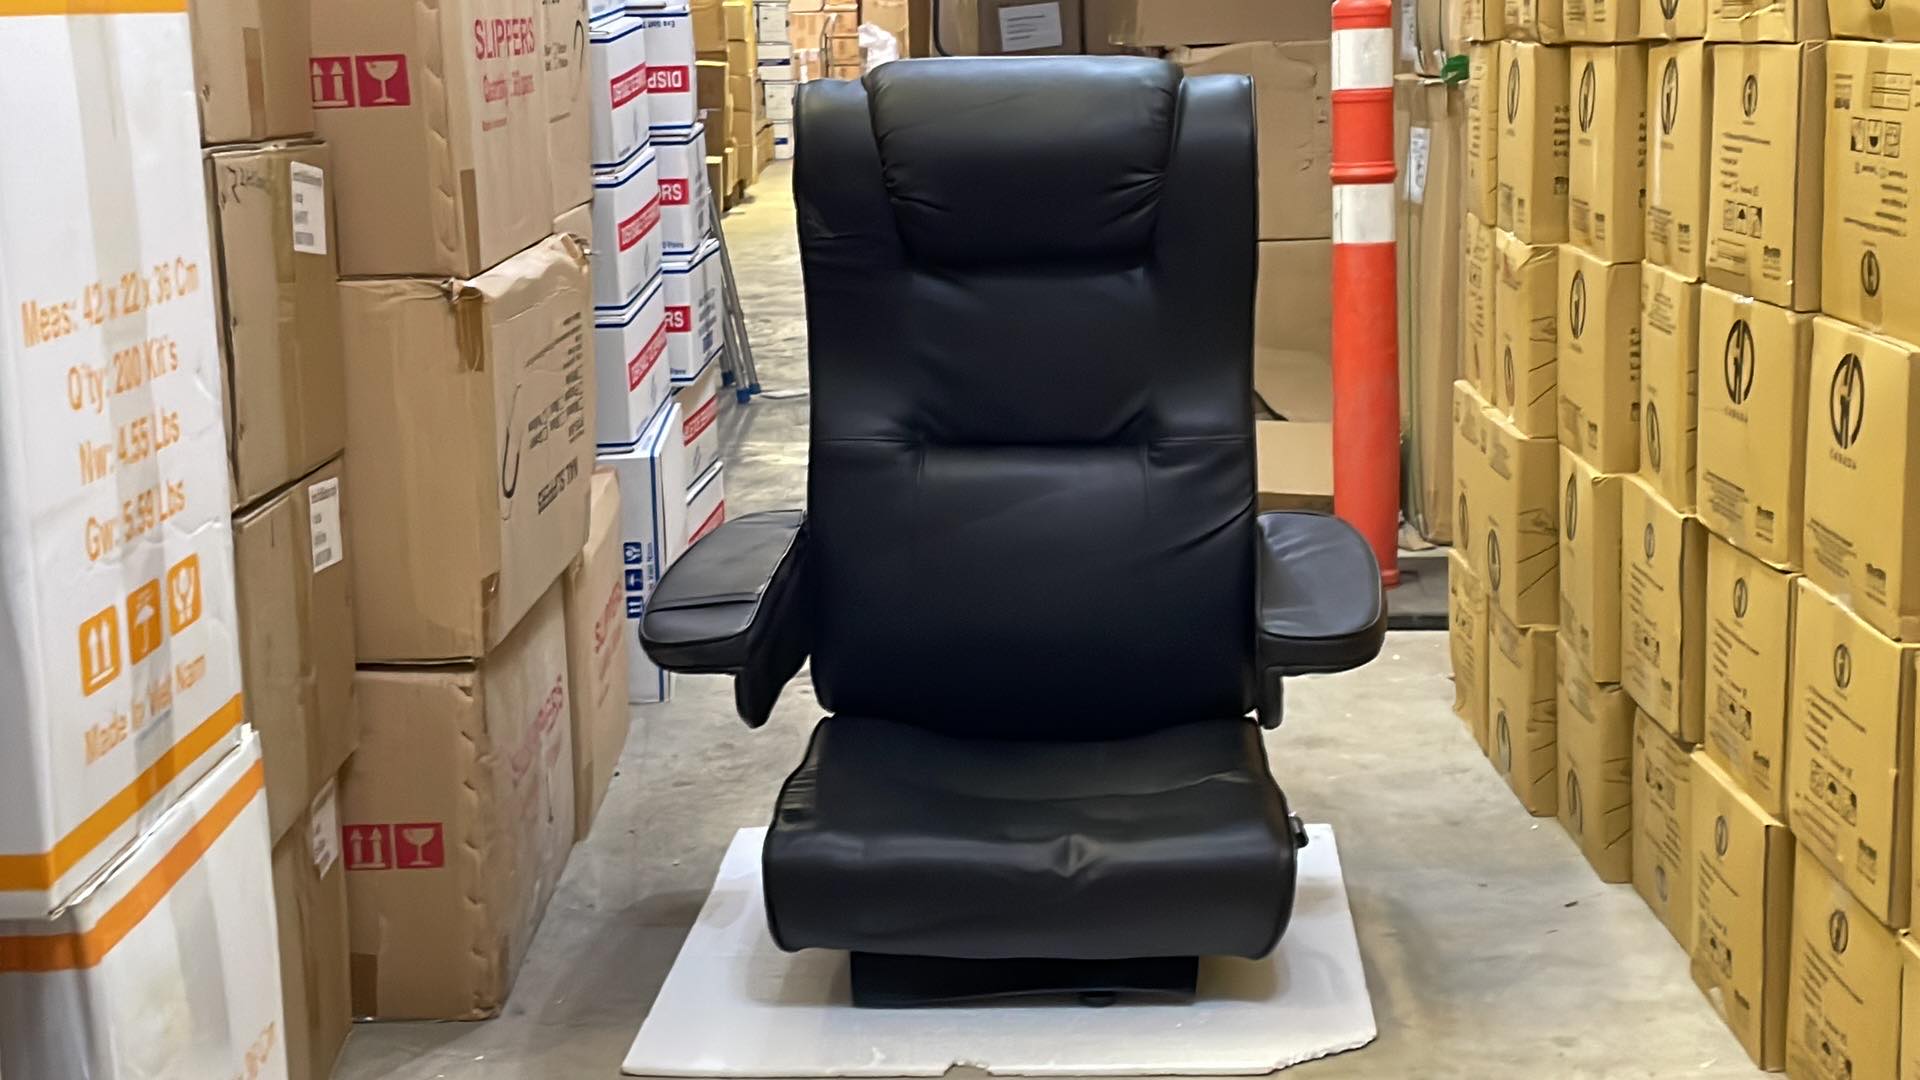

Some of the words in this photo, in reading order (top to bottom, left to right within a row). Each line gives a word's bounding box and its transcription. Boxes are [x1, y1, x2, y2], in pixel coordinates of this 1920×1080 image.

[647, 70, 682, 89] DISP
[22, 299, 77, 348] Meas:
[84, 282, 104, 325] 42
[120, 271, 141, 315] 22
[154, 262, 171, 304] 36
[113, 345, 143, 395] 200
[153, 405, 181, 452] Lbs
[158, 477, 186, 523] Lbs
